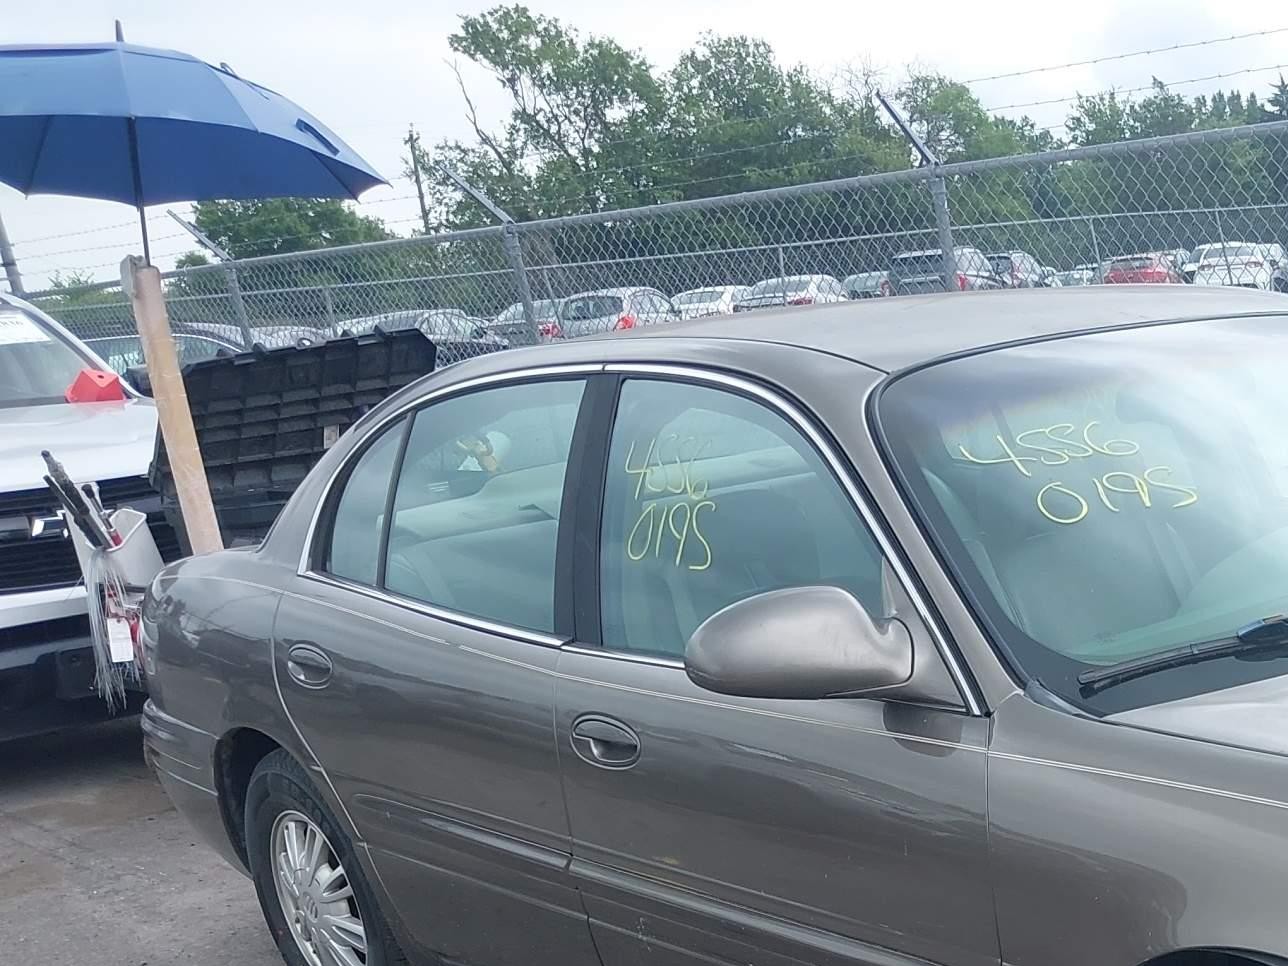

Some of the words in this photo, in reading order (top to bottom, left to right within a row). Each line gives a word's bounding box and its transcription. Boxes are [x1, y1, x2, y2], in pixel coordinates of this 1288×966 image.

[959, 420, 1140, 477] 4556
[1036, 465, 1198, 524] 0195
[626, 501, 716, 571] 0195
